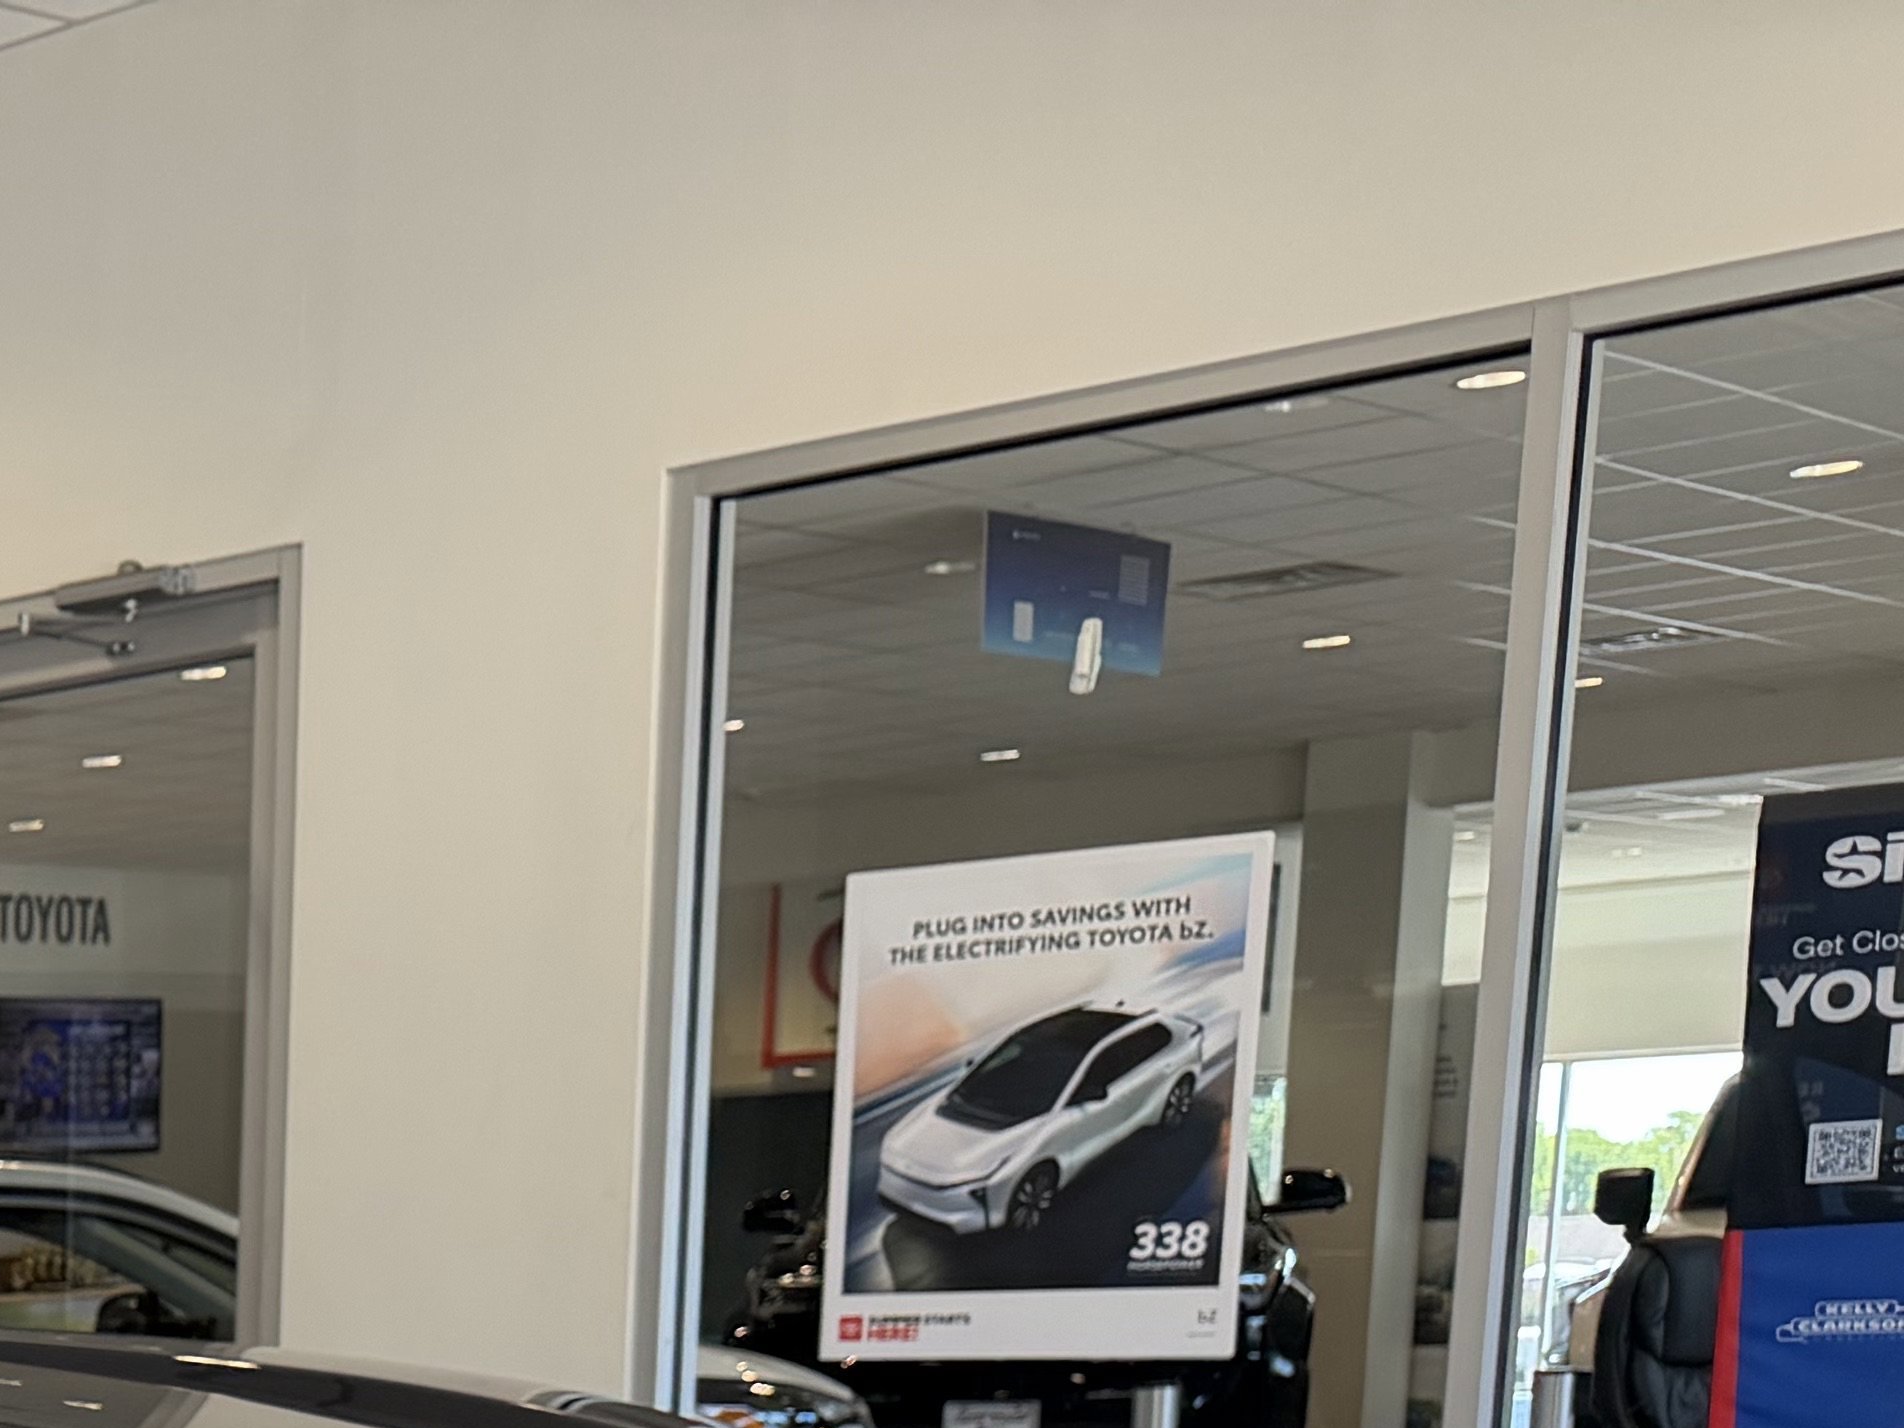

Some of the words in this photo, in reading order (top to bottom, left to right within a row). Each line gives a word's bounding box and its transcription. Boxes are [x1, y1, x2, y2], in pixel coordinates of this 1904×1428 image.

[912, 914, 967, 940] PLUG
[972, 910, 1024, 934] INTO
[1029, 899, 1126, 929] SAVINGS
[1132, 894, 1192, 919] WITH
[889, 944, 928, 966] THE
[932, 930, 1081, 963] ELECTRIFYING
[1087, 922, 1173, 948] TOYOTA
[1180, 920, 1214, 941] bZ.
[1792, 934, 1845, 960] Get
[1129, 1220, 1210, 1260] 338
